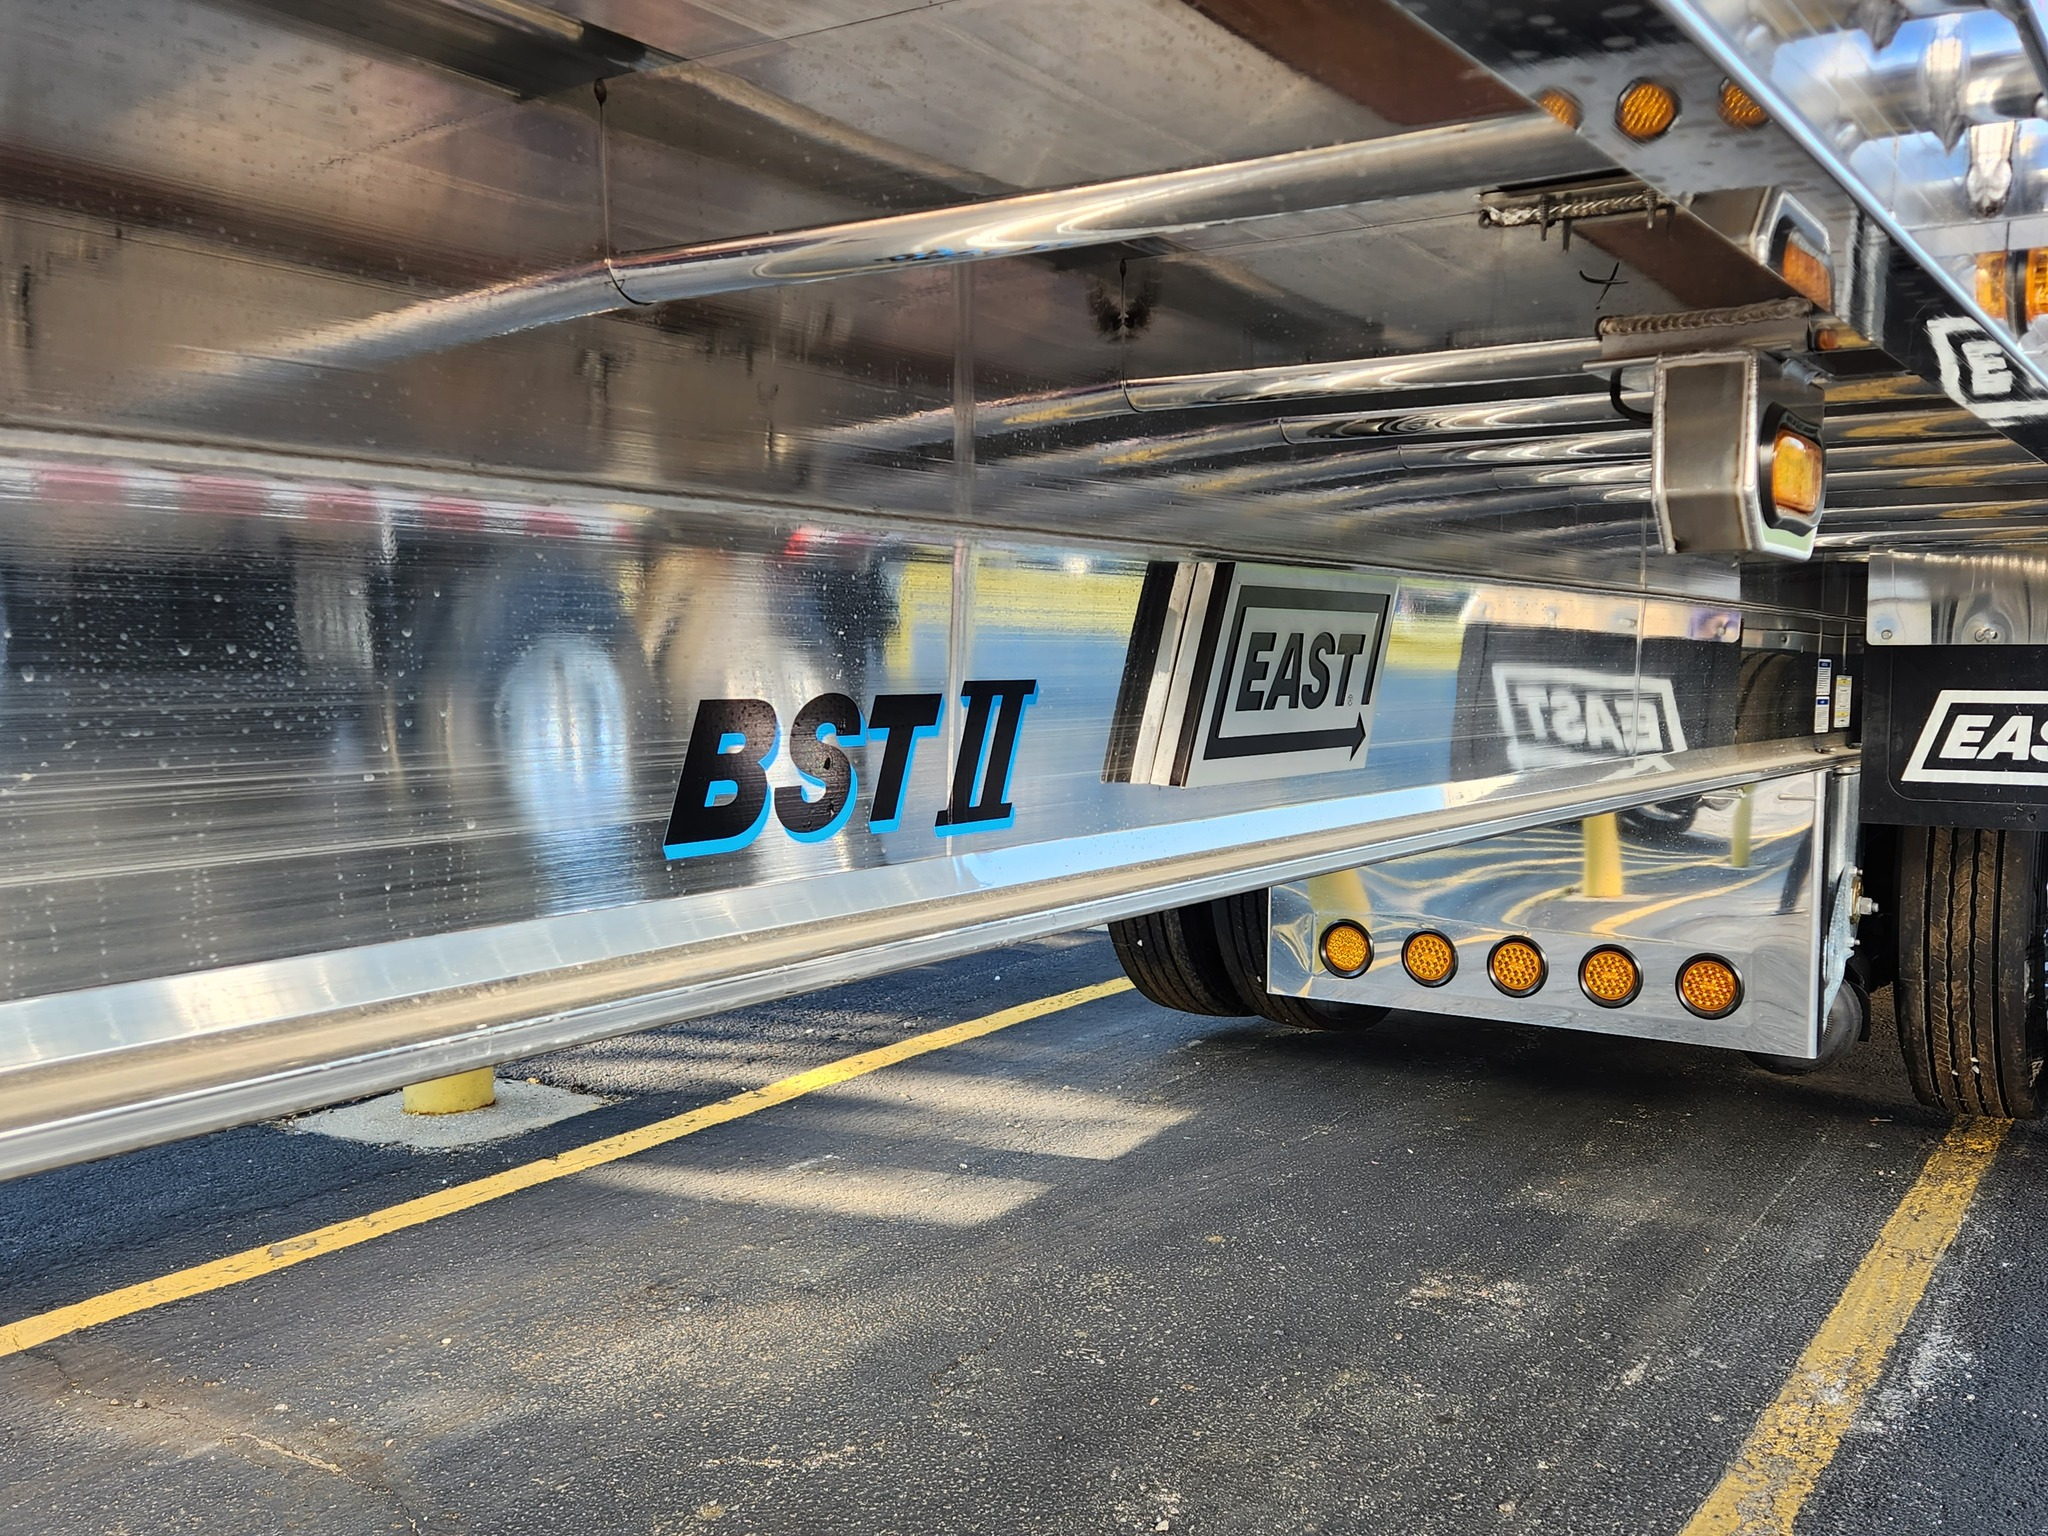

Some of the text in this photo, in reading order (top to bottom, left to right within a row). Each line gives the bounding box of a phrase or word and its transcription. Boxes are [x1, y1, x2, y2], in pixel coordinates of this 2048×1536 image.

[1235, 632, 1367, 711] EAST
[663, 679, 1039, 859] BST II
